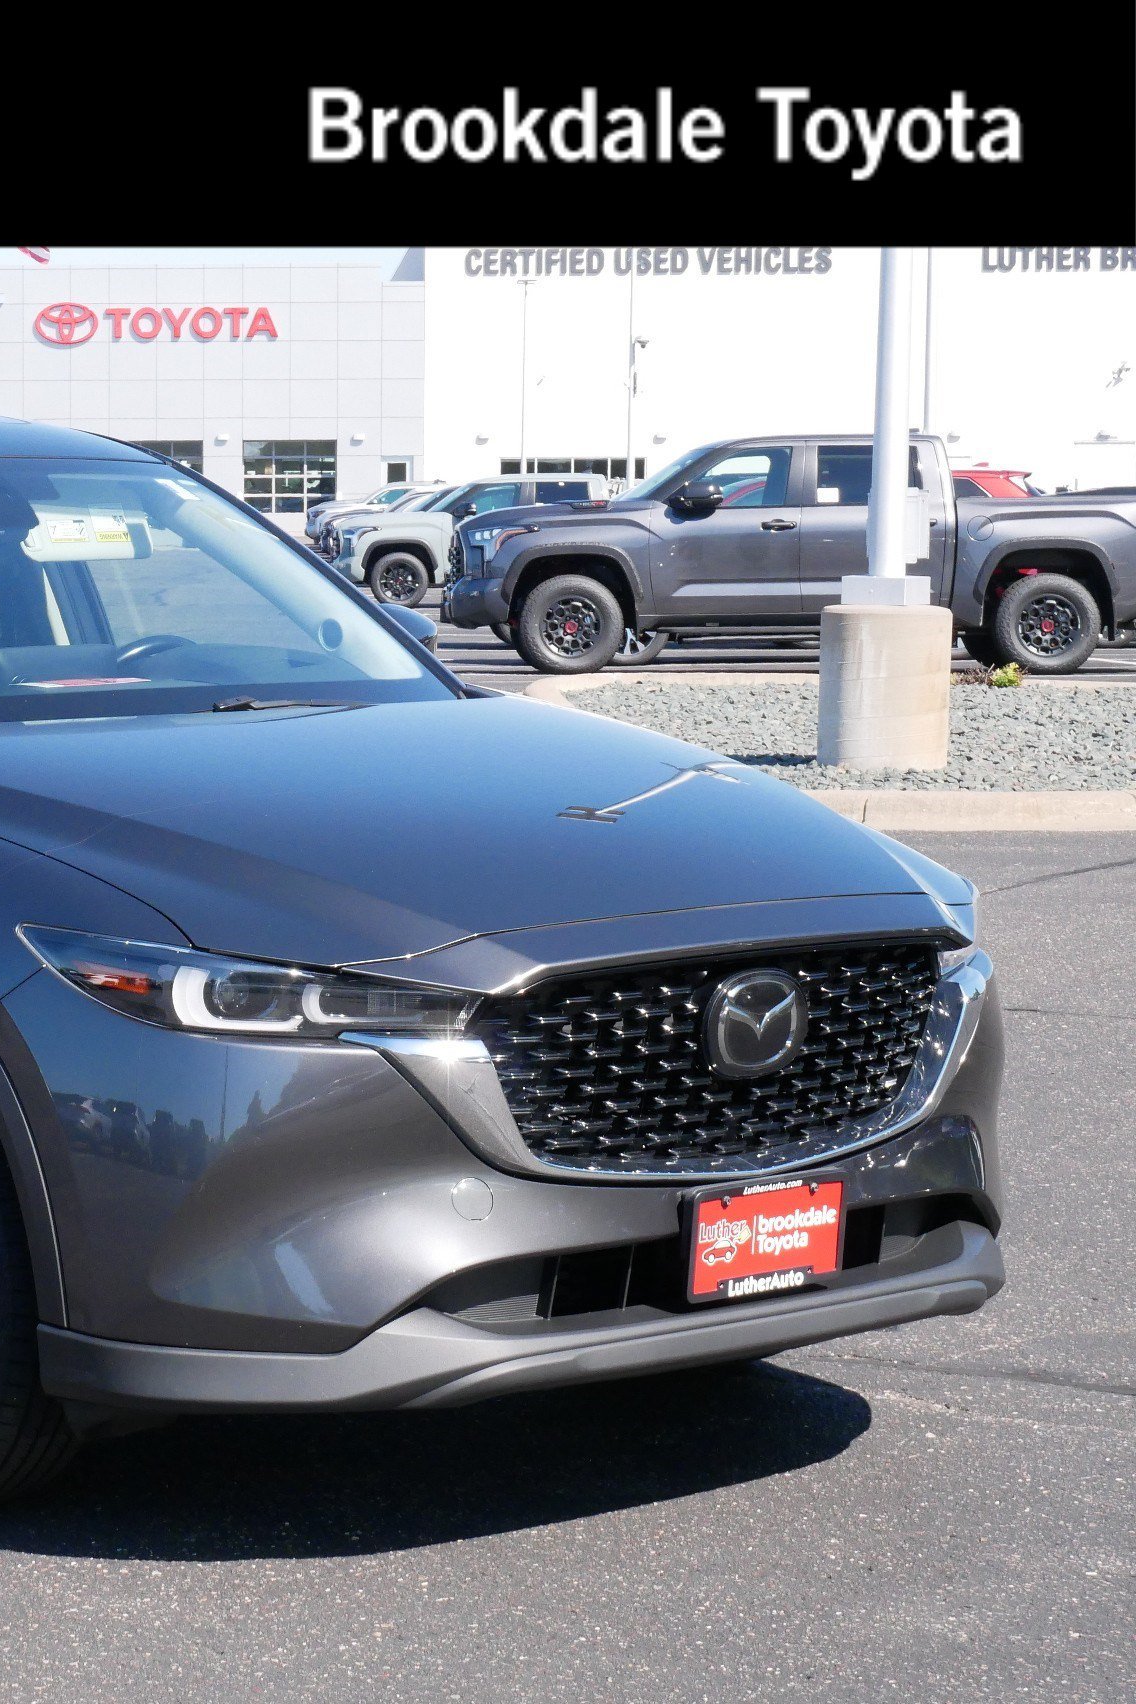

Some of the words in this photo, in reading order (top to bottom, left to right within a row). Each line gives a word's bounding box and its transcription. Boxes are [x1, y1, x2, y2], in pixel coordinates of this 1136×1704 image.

[465, 247, 605, 276] CERTIFIED
[614, 247, 689, 276] USED
[696, 247, 832, 275] VEHICLES
[981, 247, 1091, 273] LUTHER
[103, 306, 279, 341] TOYOTA
[742, 1179, 803, 1196] LutherAuto.com
[698, 1218, 748, 1244] Luther
[757, 1204, 838, 1234] brookdale
[756, 1230, 809, 1256] Toyota
[727, 1269, 805, 1298] LutherAuto
